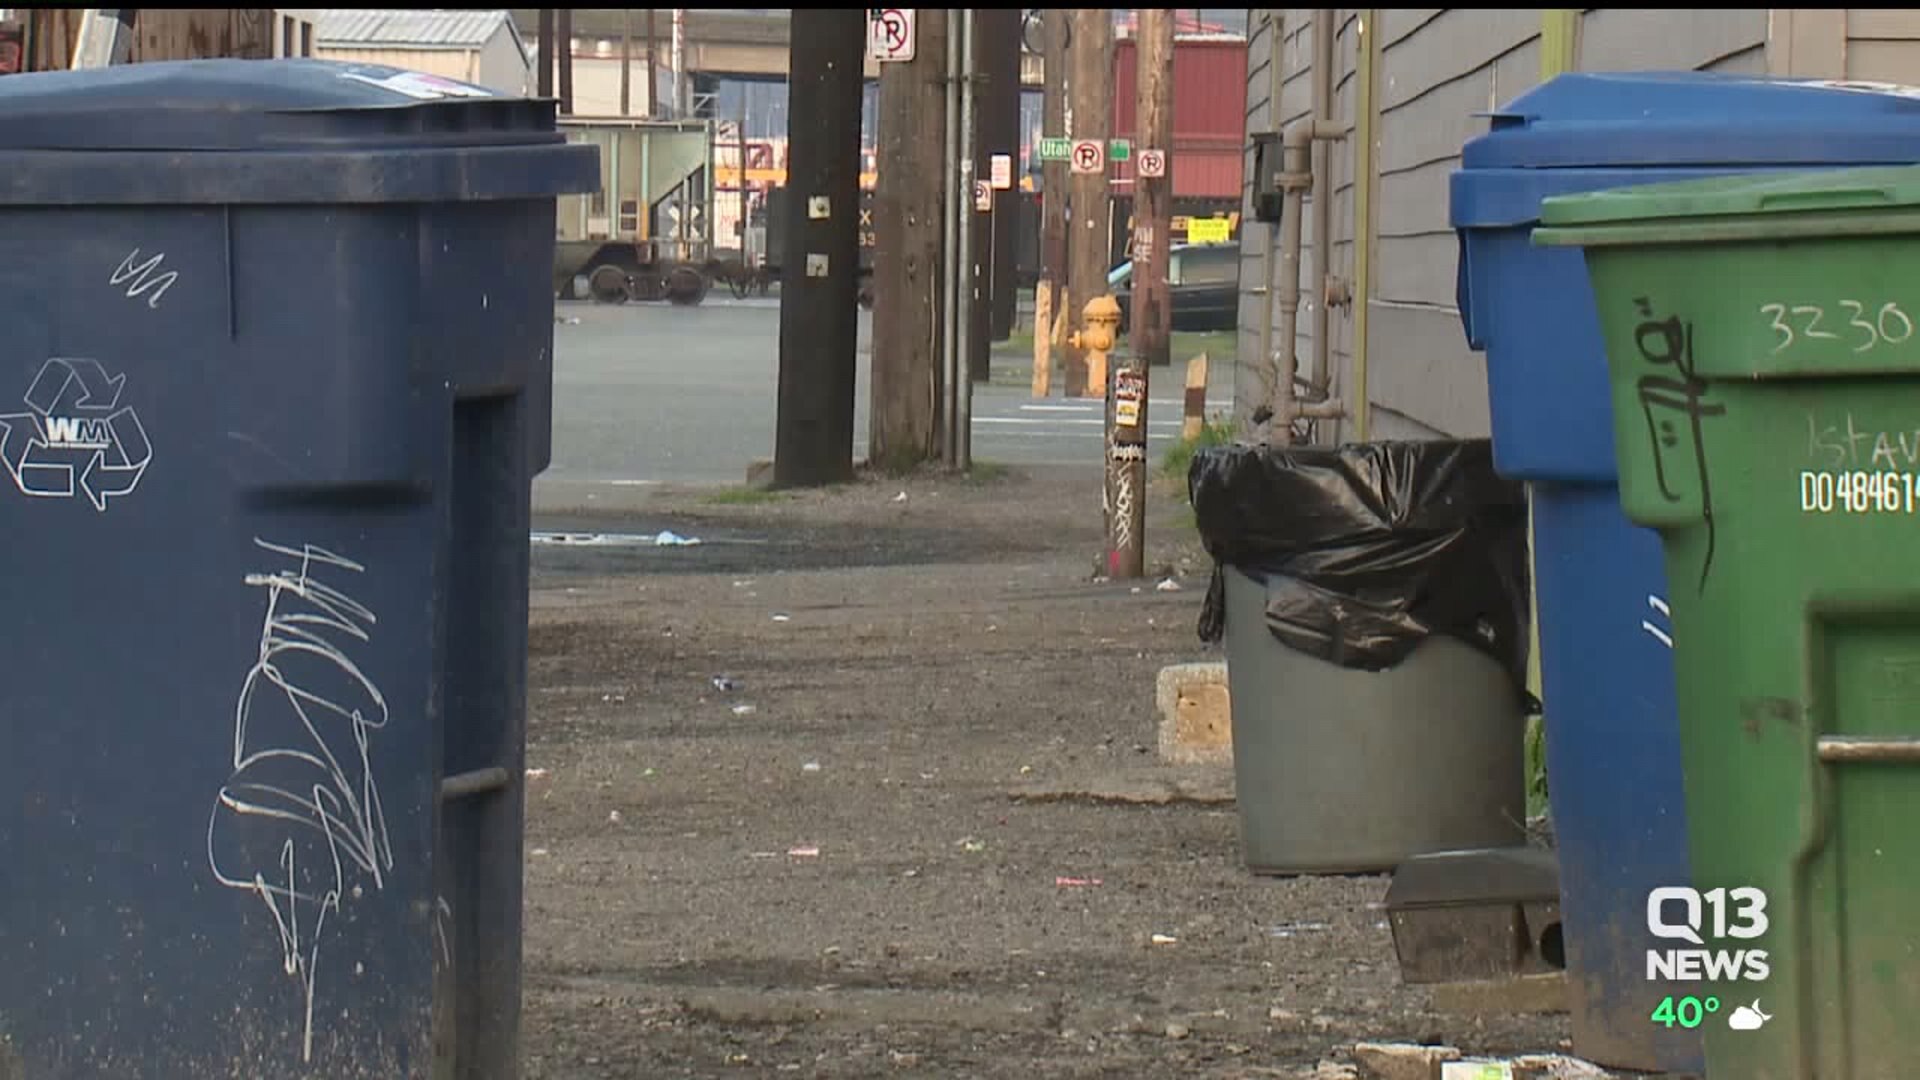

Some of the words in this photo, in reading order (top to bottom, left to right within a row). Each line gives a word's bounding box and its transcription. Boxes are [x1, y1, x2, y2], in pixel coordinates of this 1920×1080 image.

[1041, 141, 1071, 157] Utah
[1760, 299, 1913, 352] 3230
[46, 416, 110, 443] WM
